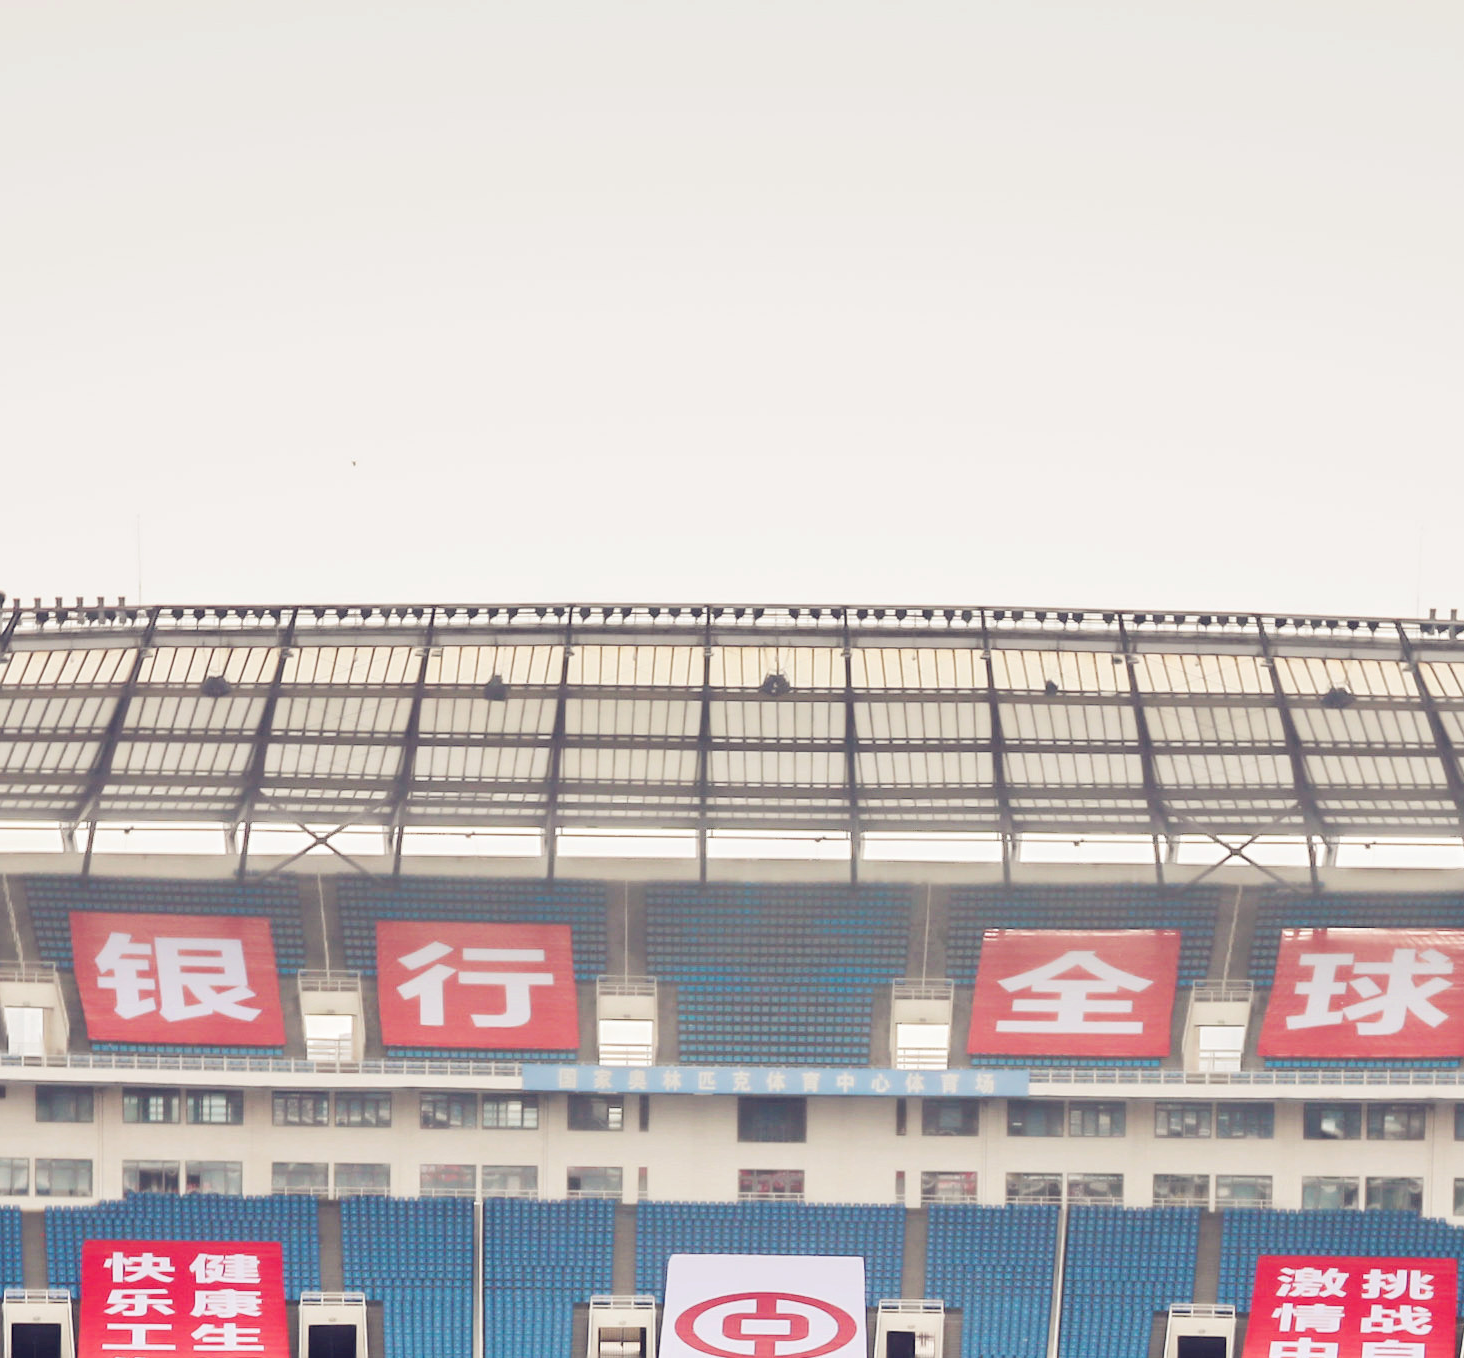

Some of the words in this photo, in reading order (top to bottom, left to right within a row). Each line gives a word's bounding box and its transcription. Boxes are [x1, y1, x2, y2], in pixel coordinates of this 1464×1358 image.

[95, 932, 262, 1022] 银
[396, 940, 554, 1027] 行
[997, 950, 1154, 1034] 全
[1286, 948, 1454, 1035] 球
[558, 1068, 995, 1094] 国家奥林匹克体育中心体育场
